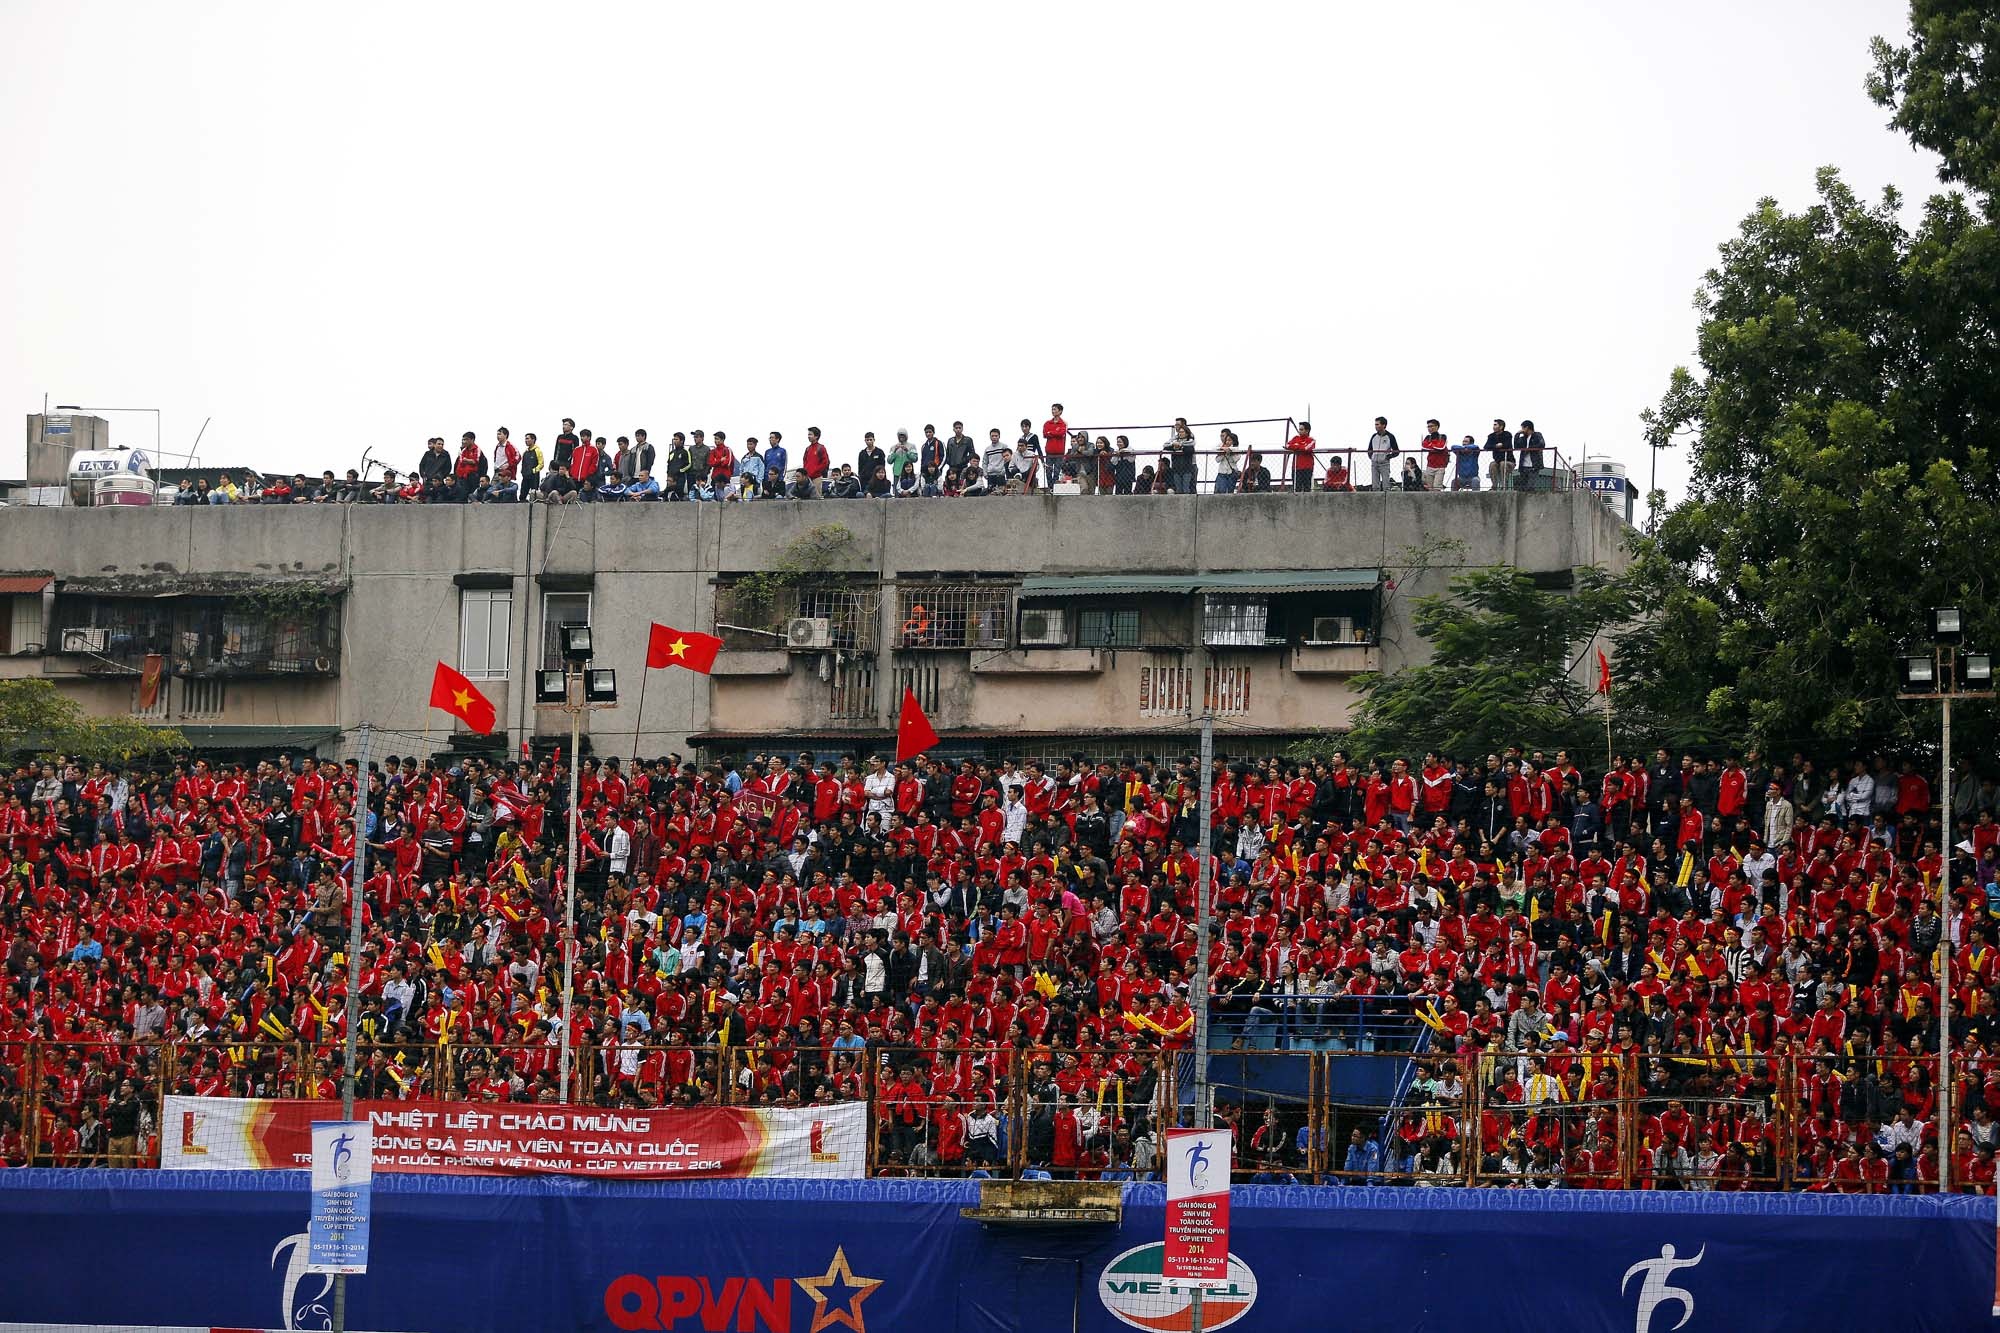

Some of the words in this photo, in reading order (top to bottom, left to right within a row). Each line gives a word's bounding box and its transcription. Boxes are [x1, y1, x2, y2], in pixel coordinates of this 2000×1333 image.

[369, 1108, 438, 1130] NHIỆT
[445, 1110, 493, 1132] LIỆT
[500, 1112, 565, 1130] CHÀO
[573, 1113, 650, 1132] MỪNG
[371, 1134, 422, 1150] BÓNG
[426, 1136, 456, 1151] ĐÁ
[464, 1140, 511, 1152] SINH
[518, 1138, 562, 1153] VIÊN
[570, 1140, 632, 1155] TOÀN
[638, 1138, 700, 1156] QUỐC
[372, 1155, 394, 1165] NH
[398, 1152, 440, 1166] QUỐC
[444, 1155, 494, 1166] PHÒNG
[500, 1156, 532, 1168] VIỆT
[536, 1160, 572, 1169] NAM
[586, 1158, 617, 1170] CÚP
[623, 1160, 684, 1170] VIETTEL
[688, 1160, 722, 1170] 2014
[1188, 1245, 1204, 1254] 2014
[604, 1274, 792, 1333] QPVN
